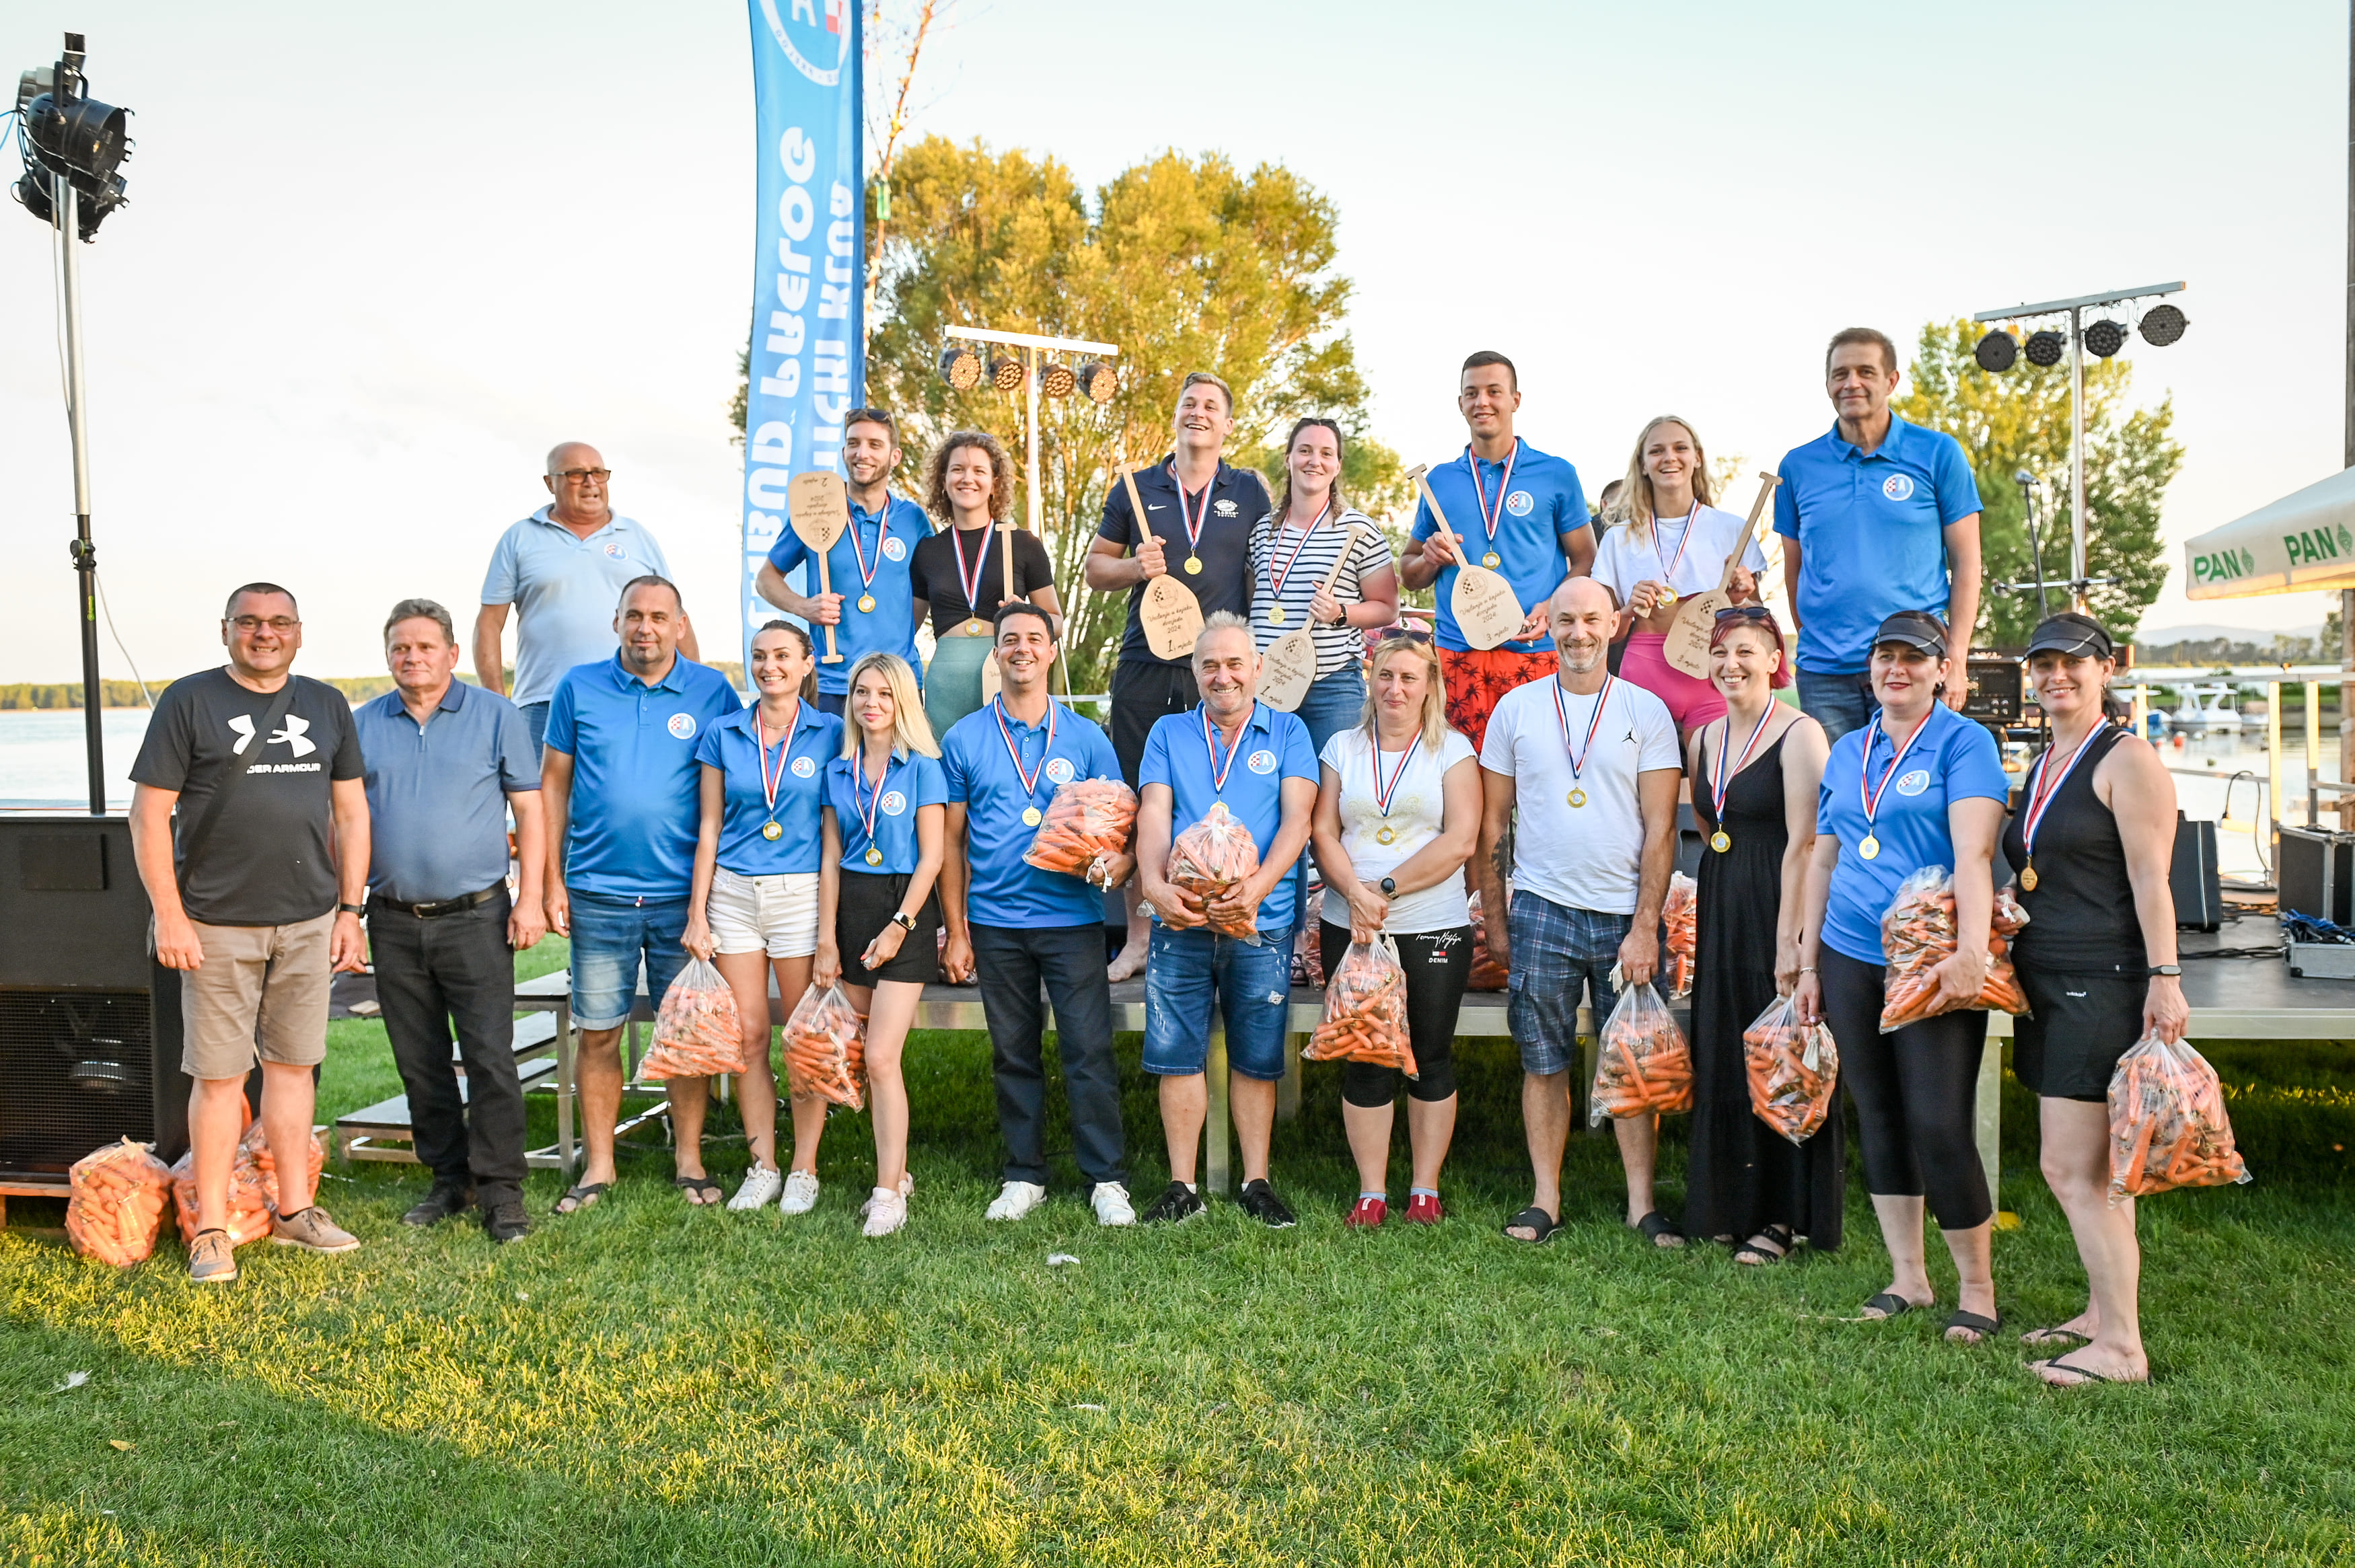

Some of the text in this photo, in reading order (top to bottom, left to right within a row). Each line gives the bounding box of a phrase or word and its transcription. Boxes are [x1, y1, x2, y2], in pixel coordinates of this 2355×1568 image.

[2284, 527, 2338, 566] PAN
[2194, 549, 2242, 584] PAN
[246, 763, 322, 774] DER ARMOUR
[1416, 934, 1440, 948] Tommy
